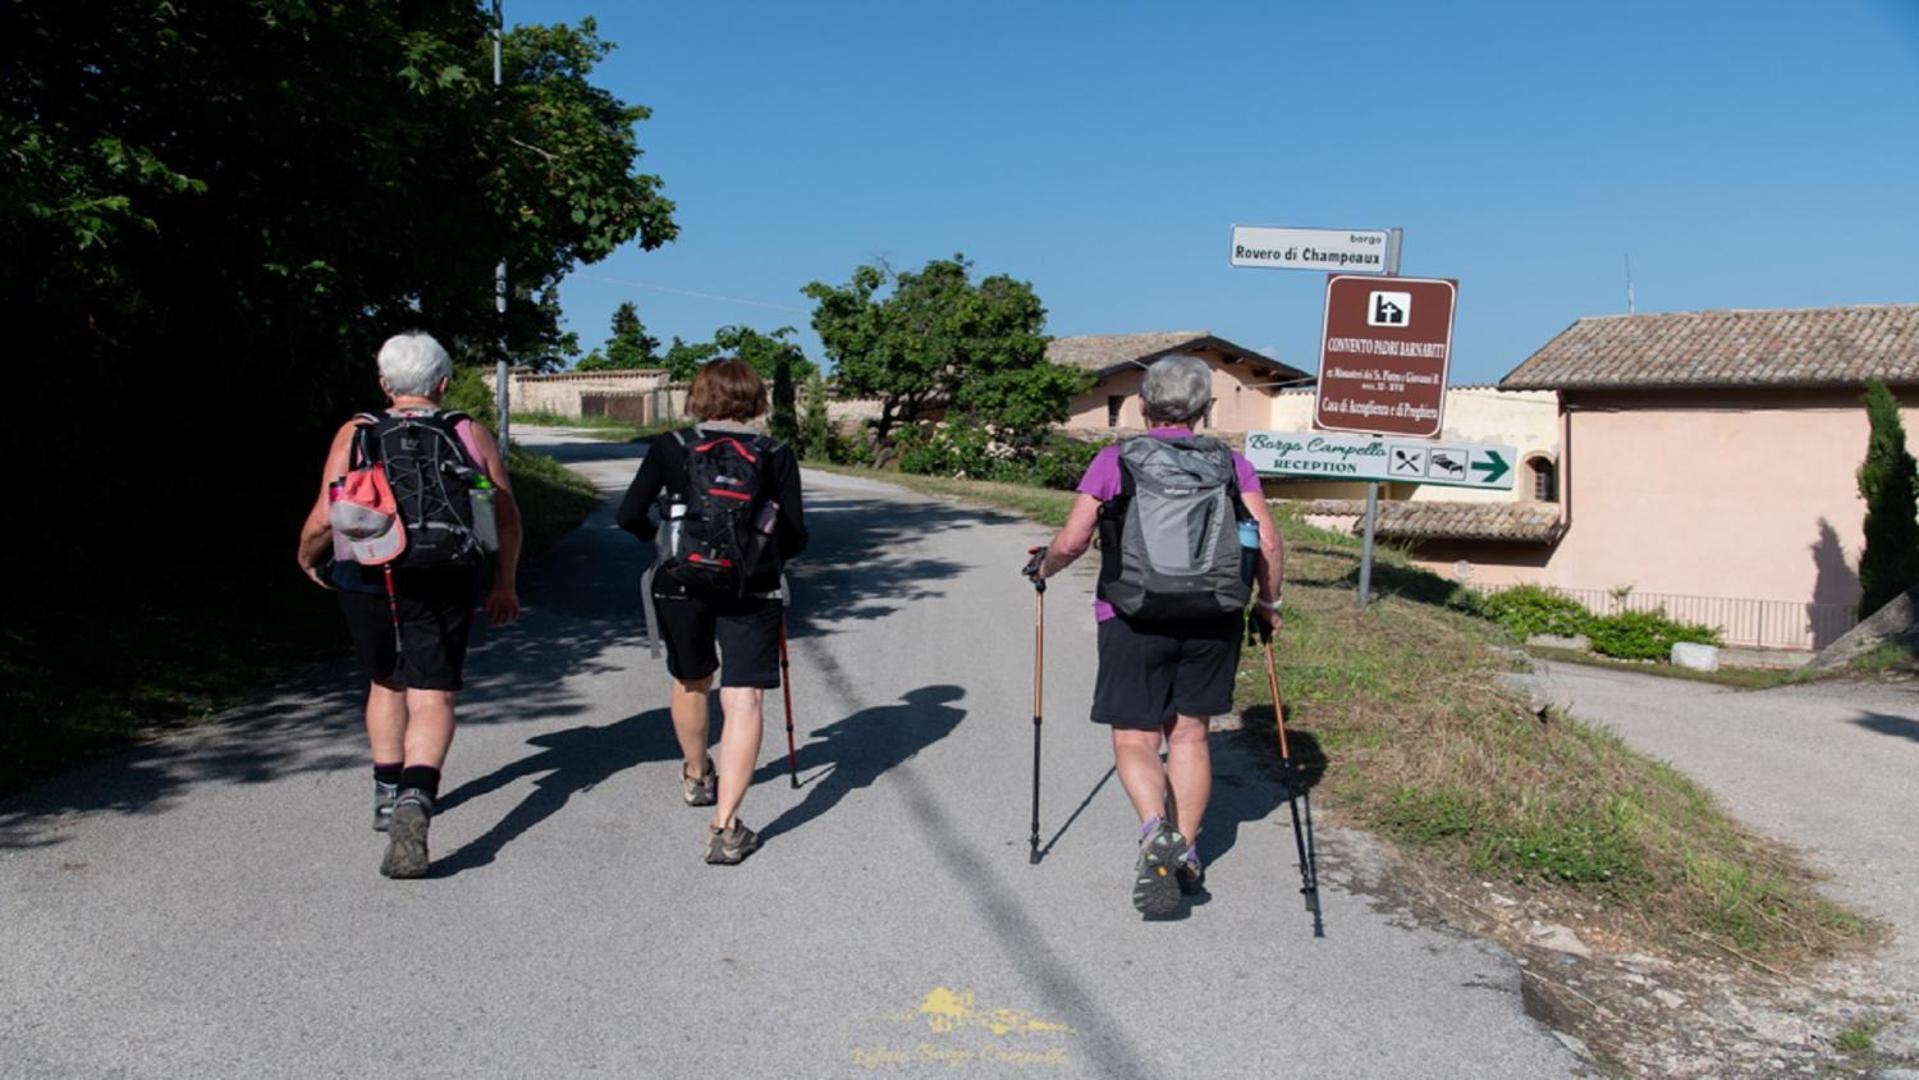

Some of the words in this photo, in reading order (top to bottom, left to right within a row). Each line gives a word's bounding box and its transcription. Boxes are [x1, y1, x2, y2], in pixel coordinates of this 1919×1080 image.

[1351, 235, 1382, 245] borgo
[1235, 245, 1281, 260] Rovero
[1285, 247, 1297, 260] di
[1302, 247, 1380, 266] Champeaux
[1329, 338, 1373, 354] CONVENTO
[1249, 434, 1304, 457] Borgo
[1307, 437, 1387, 460] Campello
[1274, 459, 1357, 473] RECEPTION
